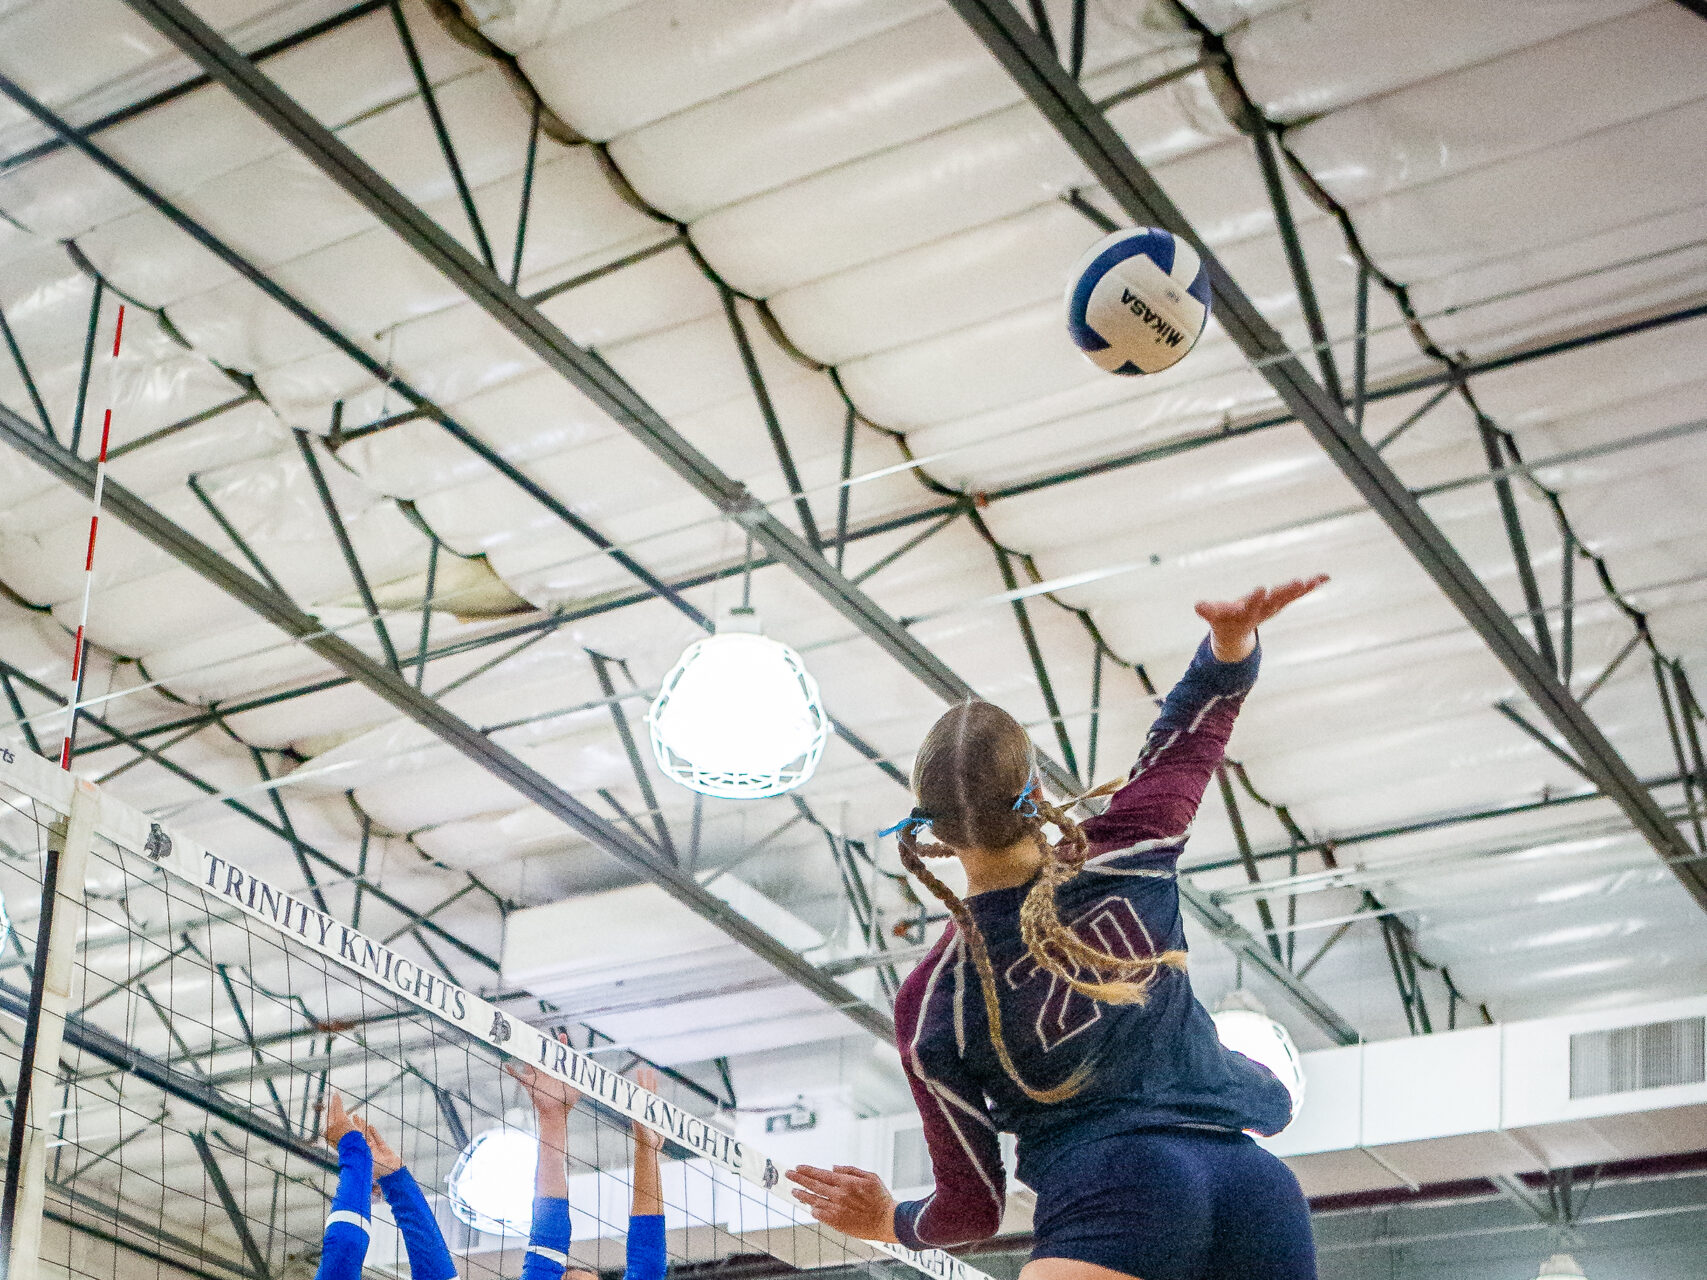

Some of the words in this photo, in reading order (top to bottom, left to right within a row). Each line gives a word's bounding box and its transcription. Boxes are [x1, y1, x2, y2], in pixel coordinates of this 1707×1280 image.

[1120, 288, 1184, 348] MIKASA
[204, 850, 333, 946] TRINITY
[339, 926, 466, 1021] KNIGHTS
[536, 1034, 642, 1113] TRINITY
[644, 1092, 744, 1168] KNIGHTS
